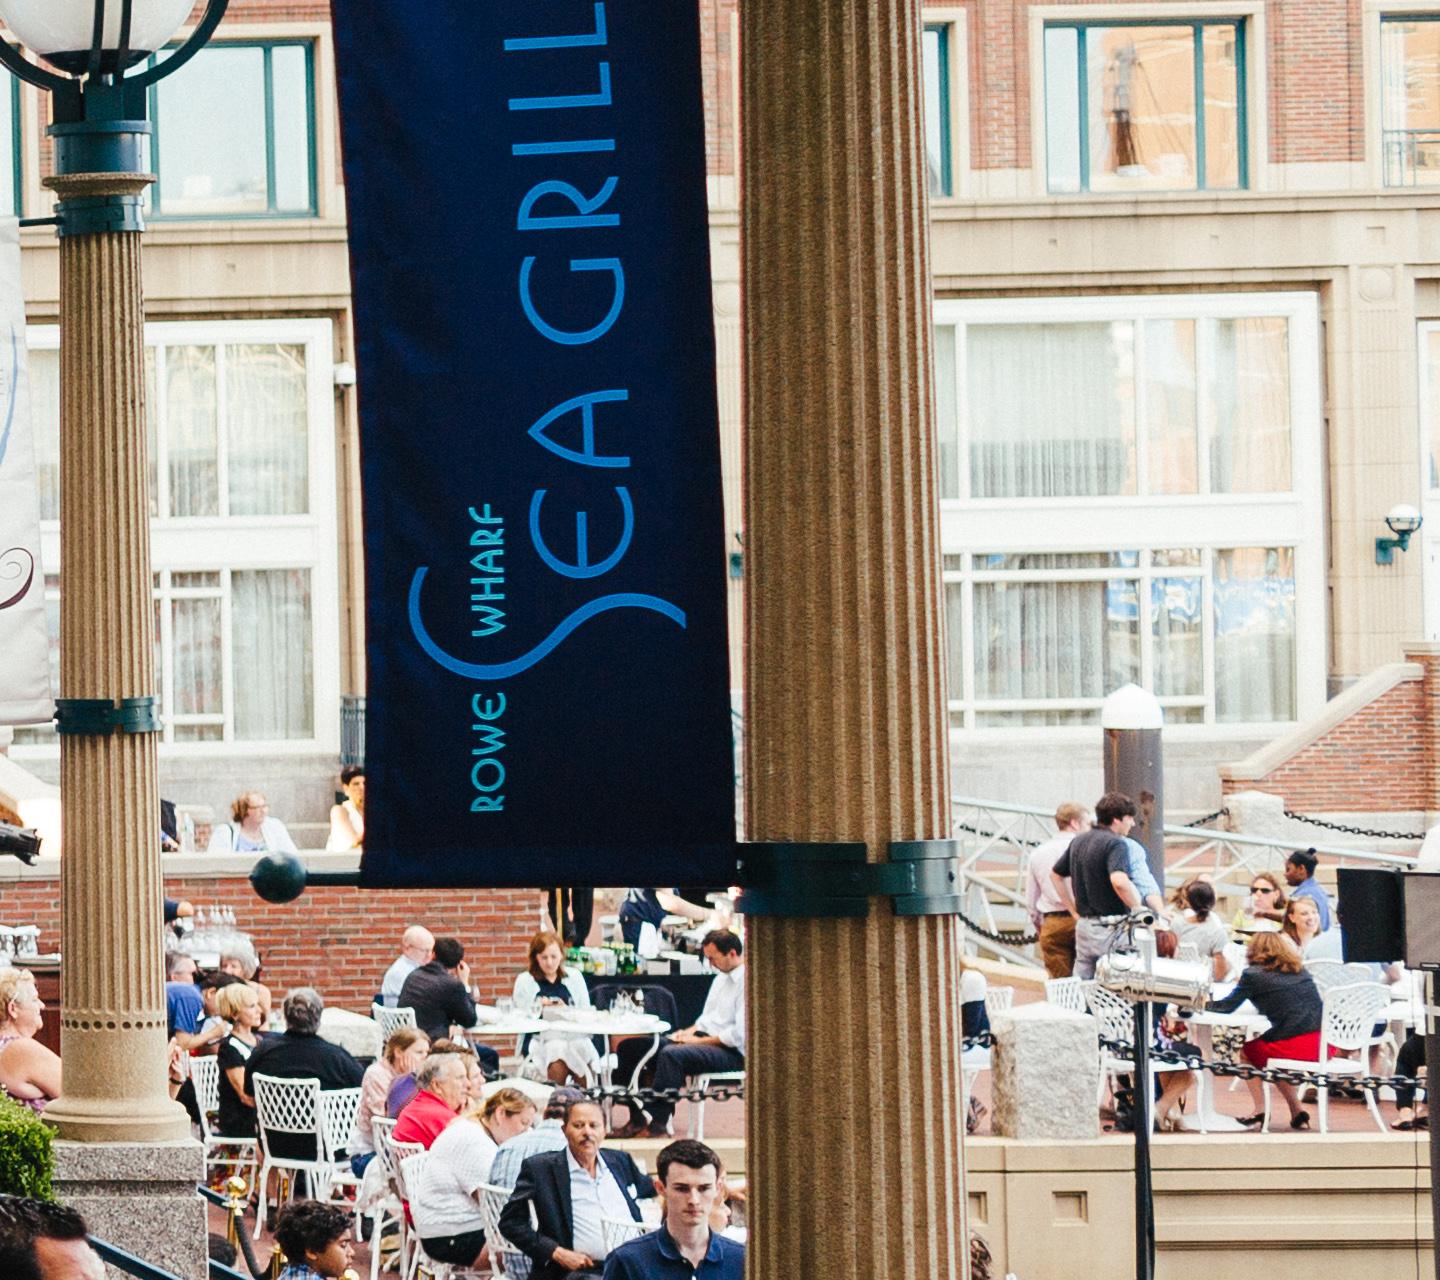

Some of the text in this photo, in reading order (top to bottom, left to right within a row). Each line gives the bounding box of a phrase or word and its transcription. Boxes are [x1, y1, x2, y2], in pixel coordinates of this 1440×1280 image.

[409, 388, 687, 680] SEA
[470, 502, 507, 813] ROWE WHARF
